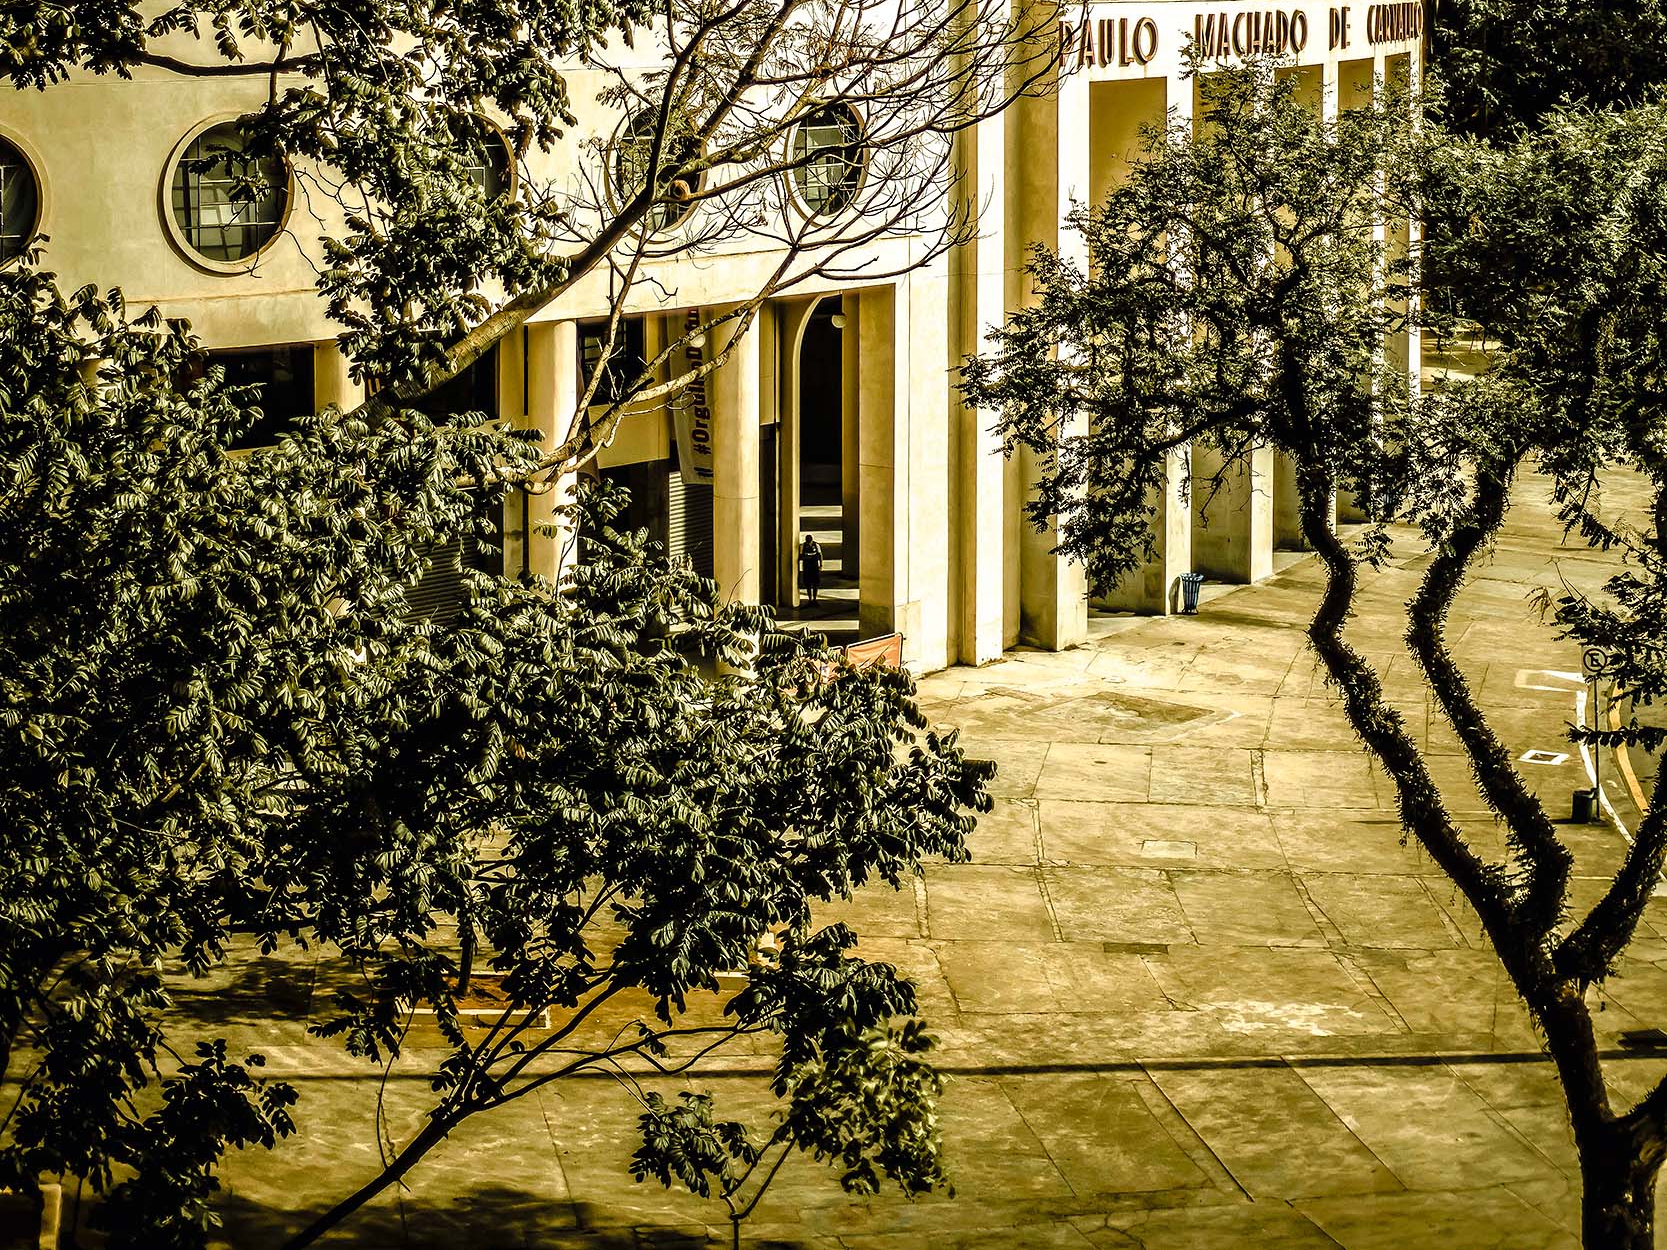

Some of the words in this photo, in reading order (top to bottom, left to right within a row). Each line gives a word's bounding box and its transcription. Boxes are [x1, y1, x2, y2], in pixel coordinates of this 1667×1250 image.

[1058, 17, 1159, 68] PAULO
[1195, 10, 1308, 60] MACHADO
[1329, 6, 1351, 51] DE
[1367, 1, 1424, 46] CARVALHO
